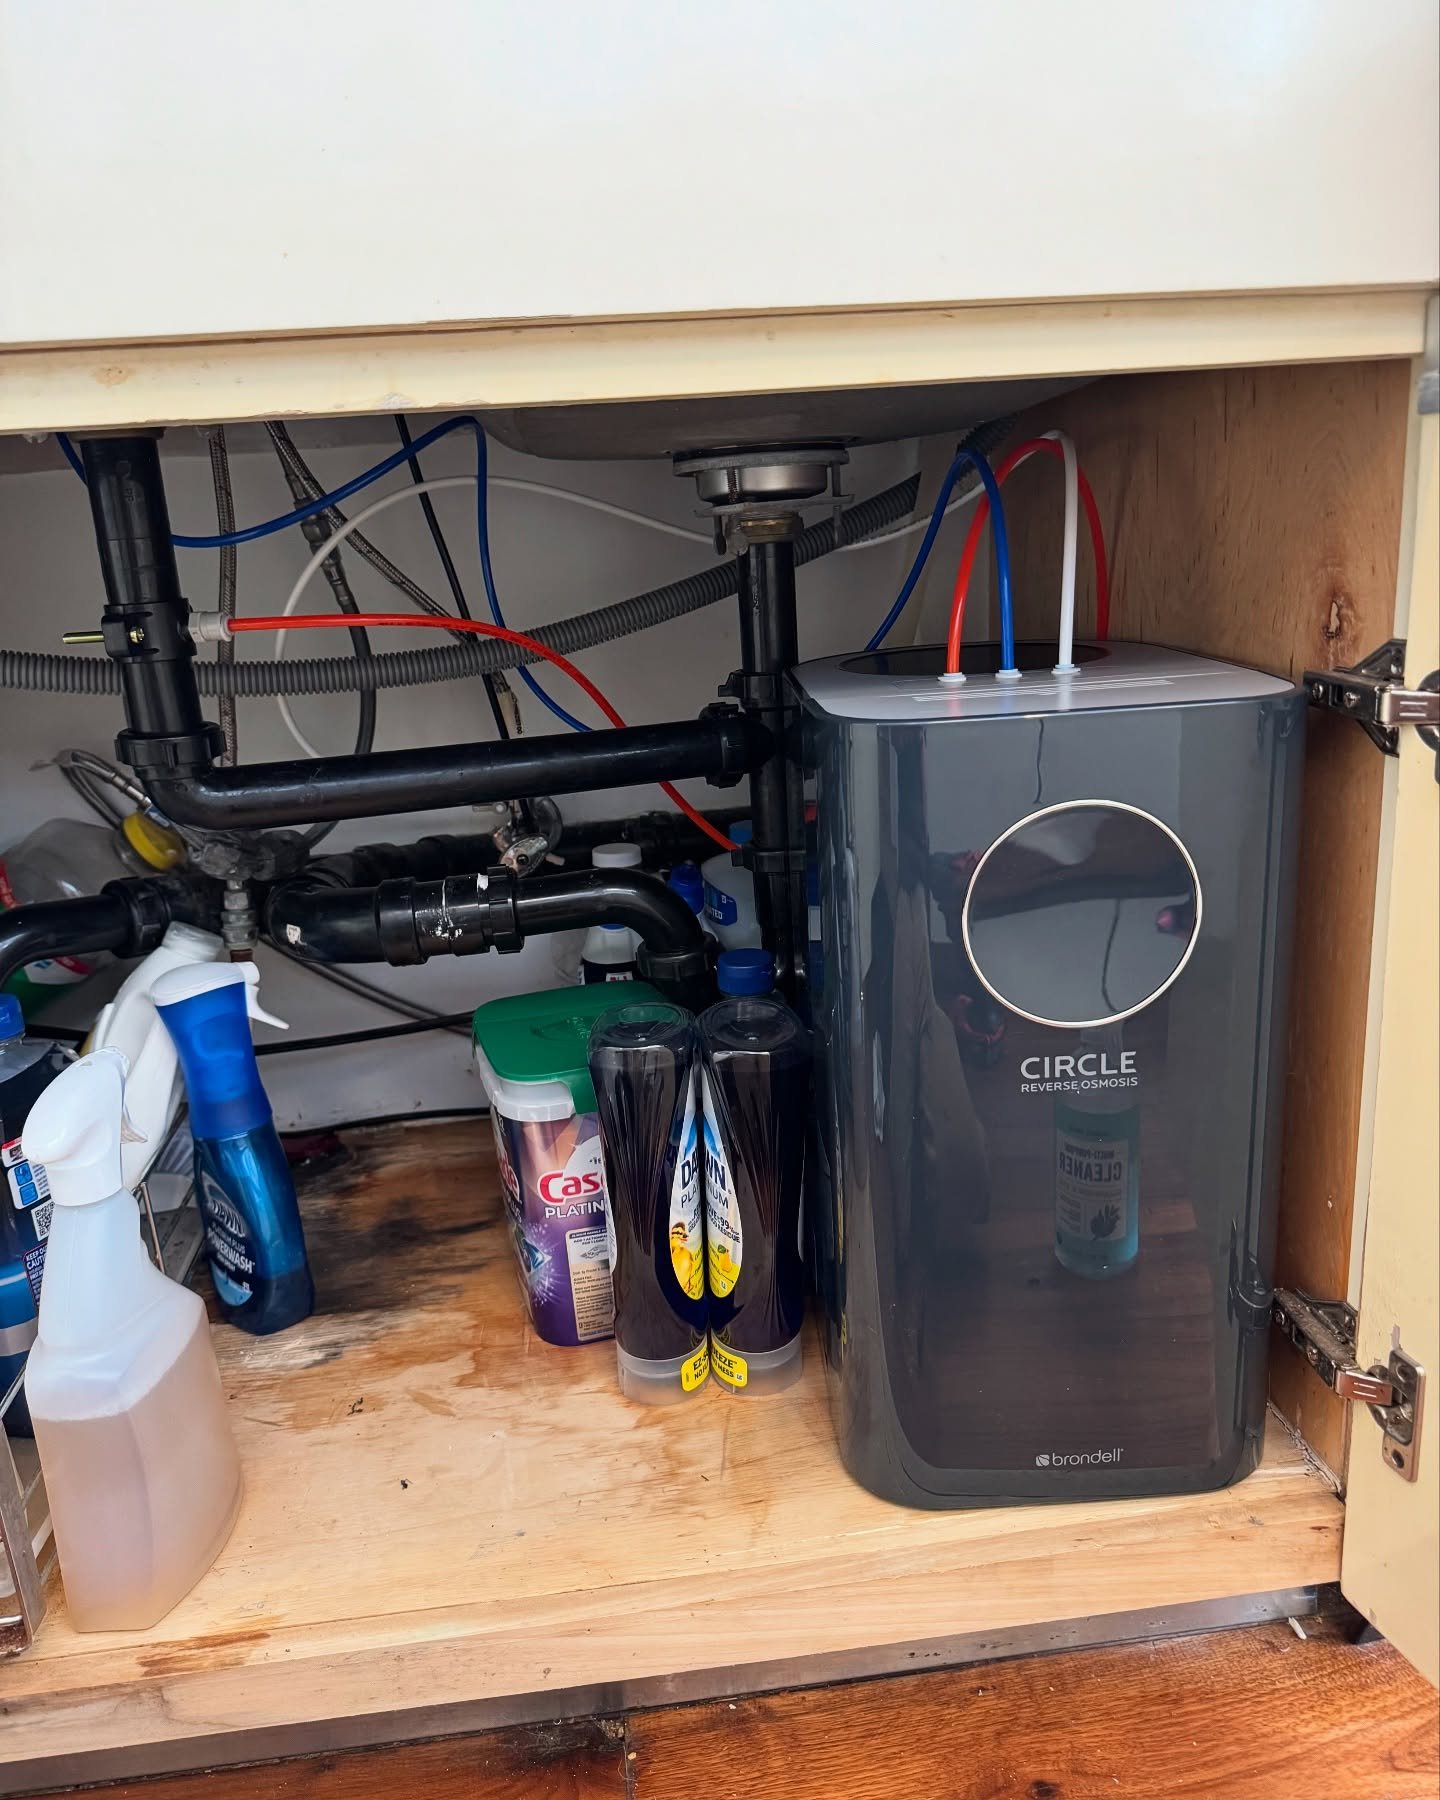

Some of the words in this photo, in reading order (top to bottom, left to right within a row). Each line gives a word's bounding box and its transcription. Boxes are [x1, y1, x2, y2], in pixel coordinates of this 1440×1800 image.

[1020, 1051, 1137, 1080] CIRCLE
[1021, 1080, 1078, 1093] REVERSE
[1080, 1077, 1138, 1090] OSMOSIS
[539, 1171, 604, 1205] Cas
[545, 1201, 605, 1219] PLATIN
[1052, 1447, 1121, 1467] brondell
